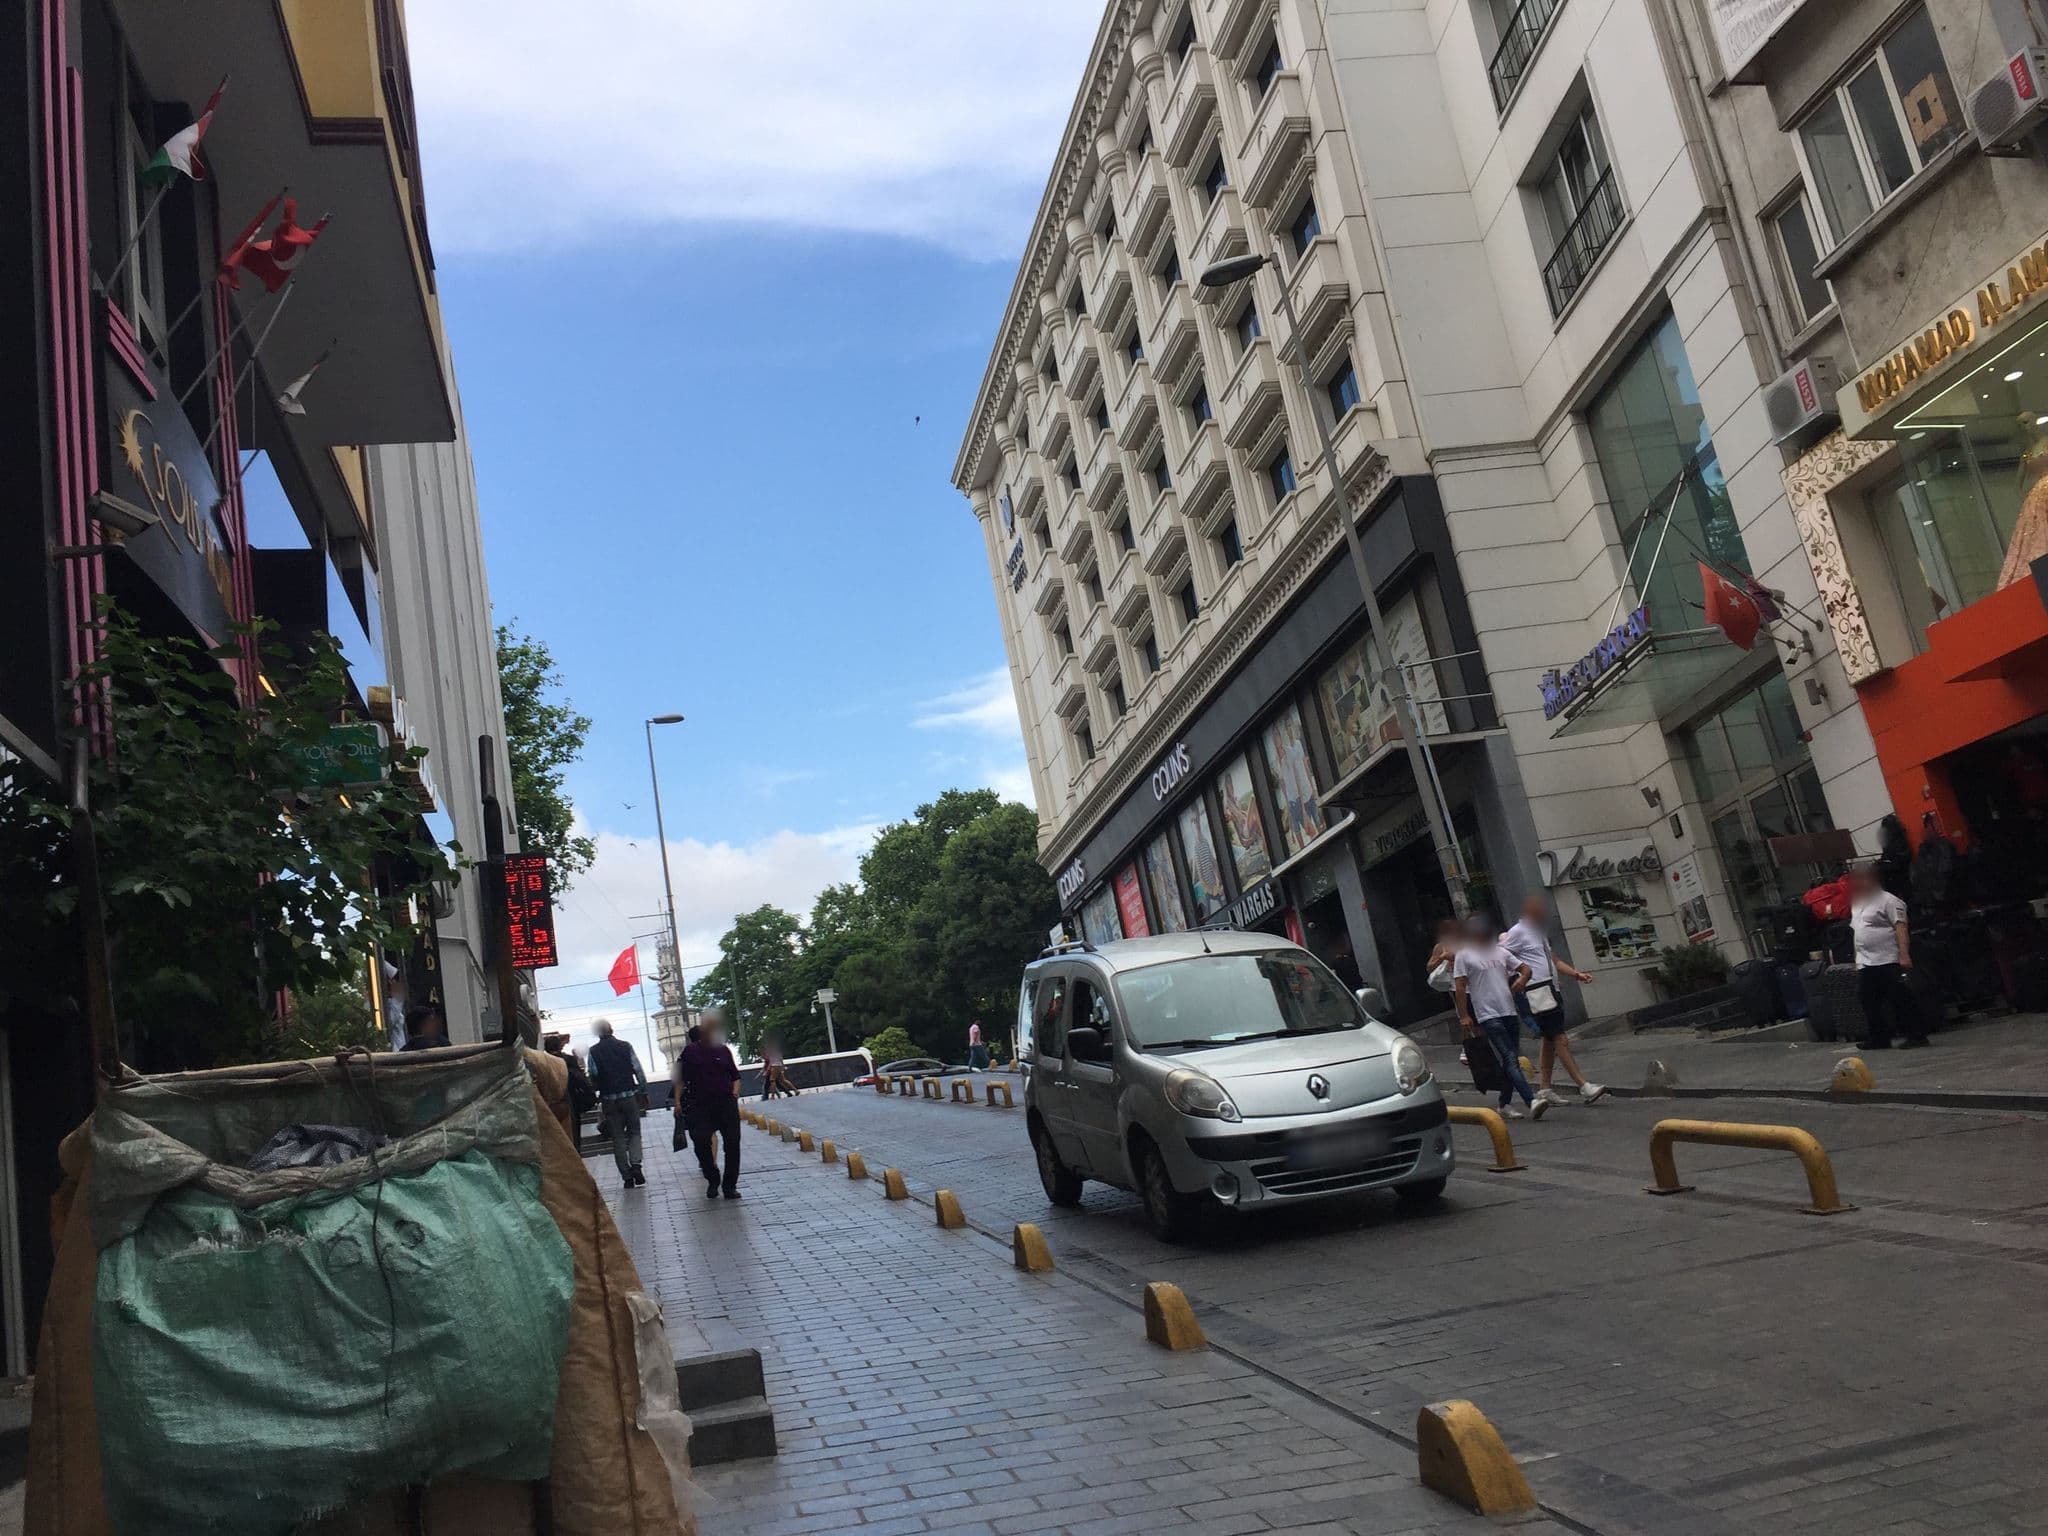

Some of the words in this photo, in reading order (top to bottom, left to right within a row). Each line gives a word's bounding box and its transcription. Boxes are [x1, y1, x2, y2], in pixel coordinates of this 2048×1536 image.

[1855, 309, 1972, 413] MOHAMAD
[1976, 239, 2048, 328] ALAM
[1152, 742, 1190, 801] COLIN'S
[1060, 857, 1085, 900] COLIN'S
[1537, 845, 1615, 886] Vista
